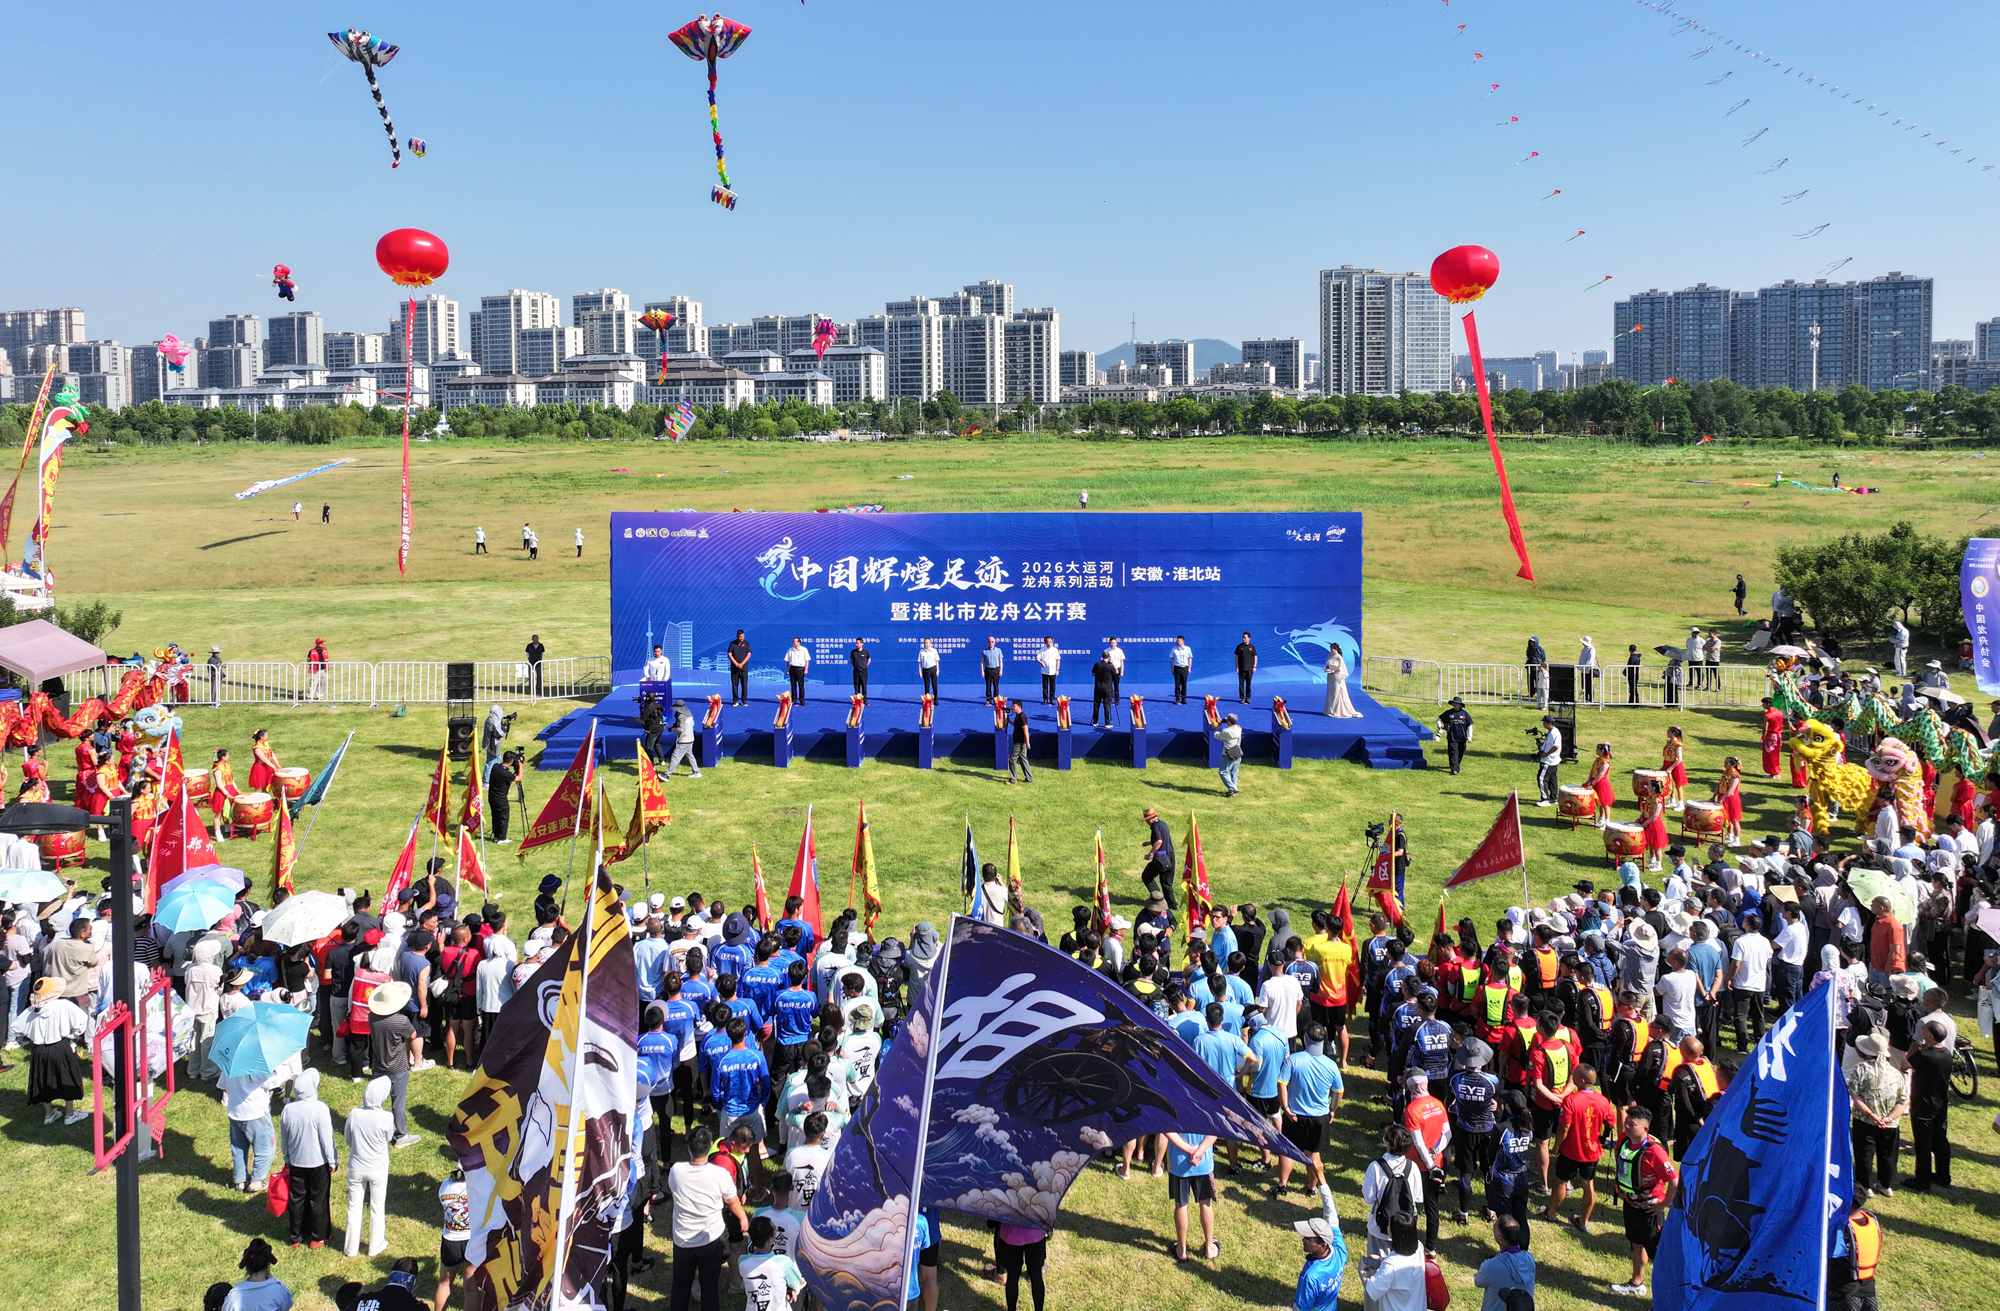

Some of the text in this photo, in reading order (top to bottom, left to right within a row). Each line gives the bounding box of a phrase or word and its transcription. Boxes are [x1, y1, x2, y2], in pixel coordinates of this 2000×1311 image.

[791, 556, 1014, 592] 中国辉煌足迹
[1022, 561, 1114, 575] 2026大运河
[1131, 566, 1221, 582] 安徽·淮北站
[1022, 575, 1114, 588] 龙舟系列活动
[891, 602, 1087, 622] 暨淮北市龙舟公开赛
[1375, 948, 1387, 956] EY
[746, 975, 777, 984] 淮北师范大学
[778, 1000, 812, 1010] 淮北师范大学
[722, 1061, 759, 1073] 淮北师范大学
